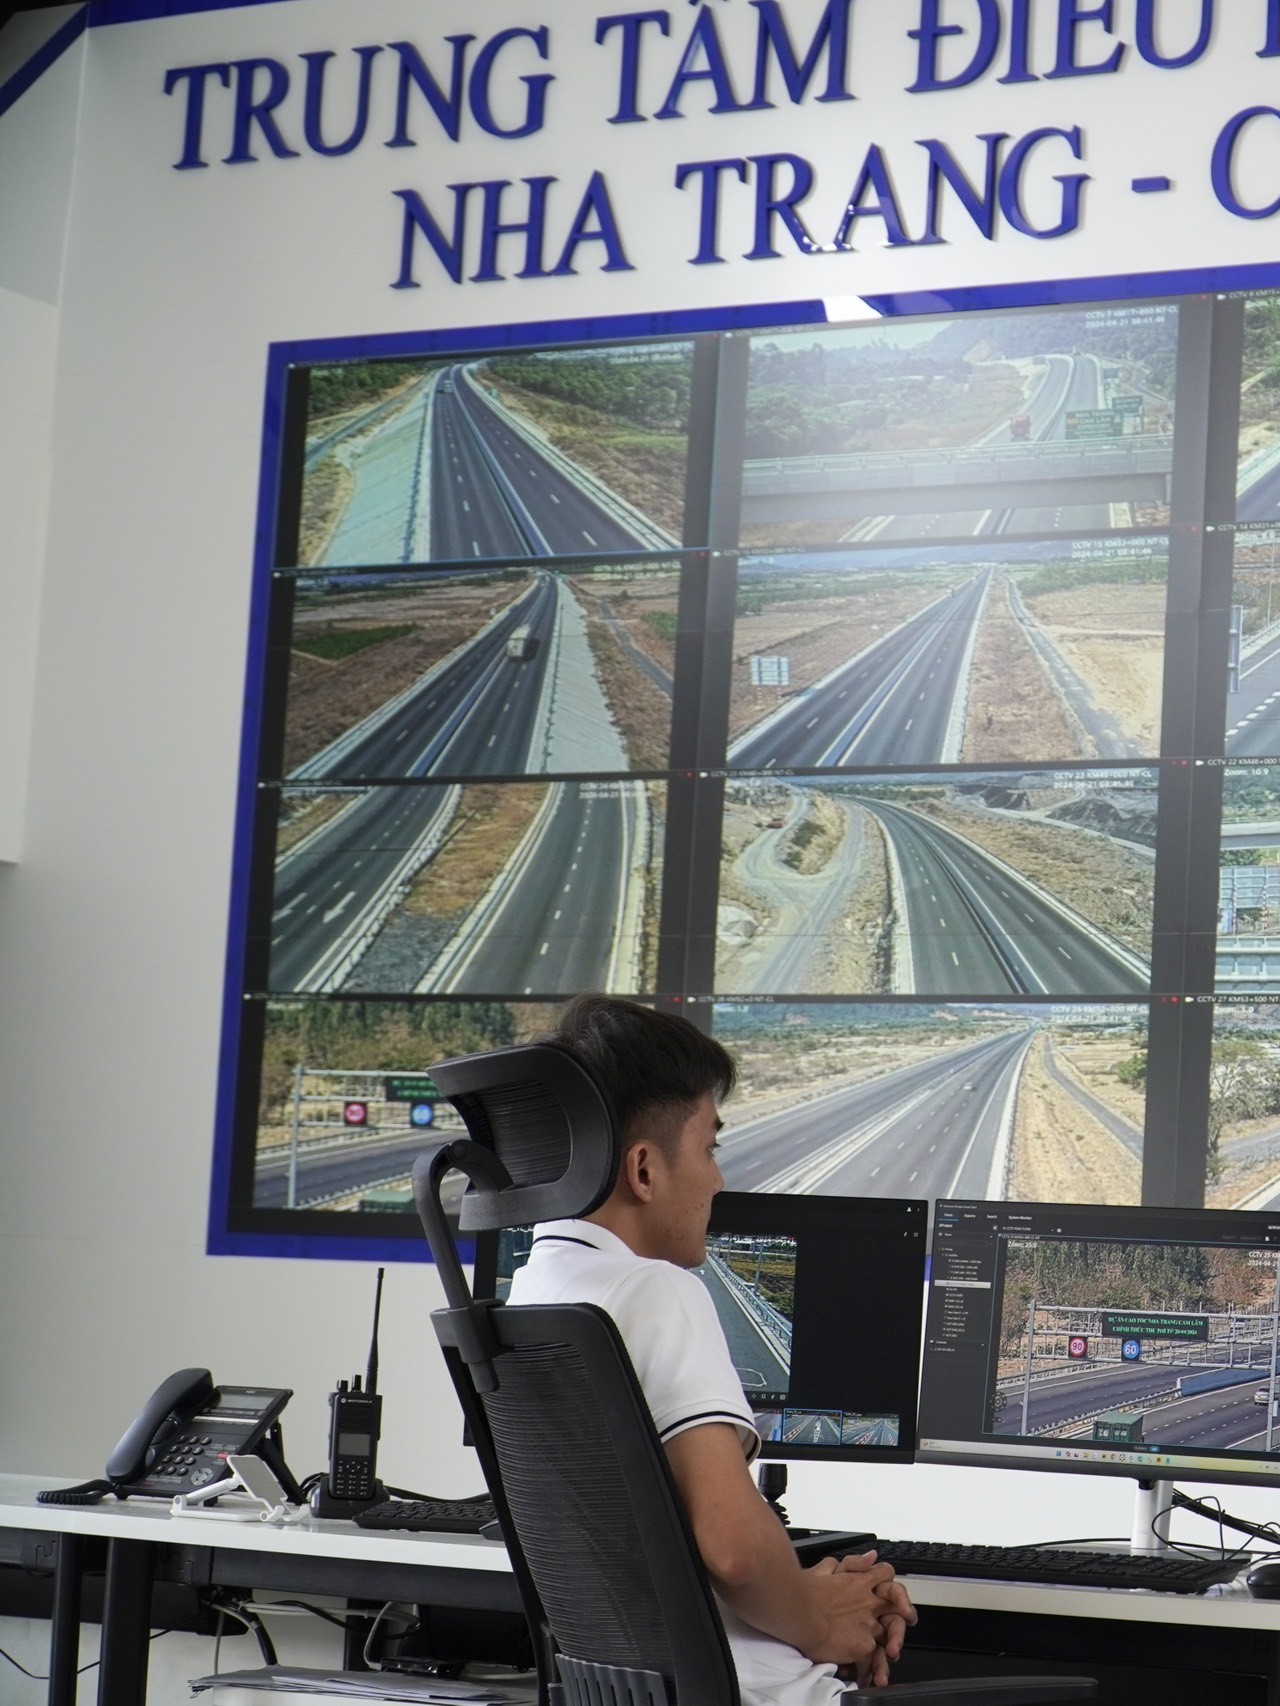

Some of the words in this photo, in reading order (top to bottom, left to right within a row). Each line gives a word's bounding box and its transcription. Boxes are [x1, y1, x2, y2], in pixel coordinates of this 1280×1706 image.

[164, 25, 556, 171] TRUNG
[391, 171, 636, 289] NHA
[675, 125, 1091, 266] TRANG
[1085, 311, 1105, 320] CCTV
[1156, 306, 1178, 315] NT-CL
[1218, 523, 1237, 531] CCTV
[1224, 768, 1250, 776] Zoom:
[1251, 768, 1269, 776] 10.9
[1248, 1251, 1263, 1259] CCTV
[1072, 1342, 1083, 1352] 90
[1124, 1345, 1137, 1354] 60
